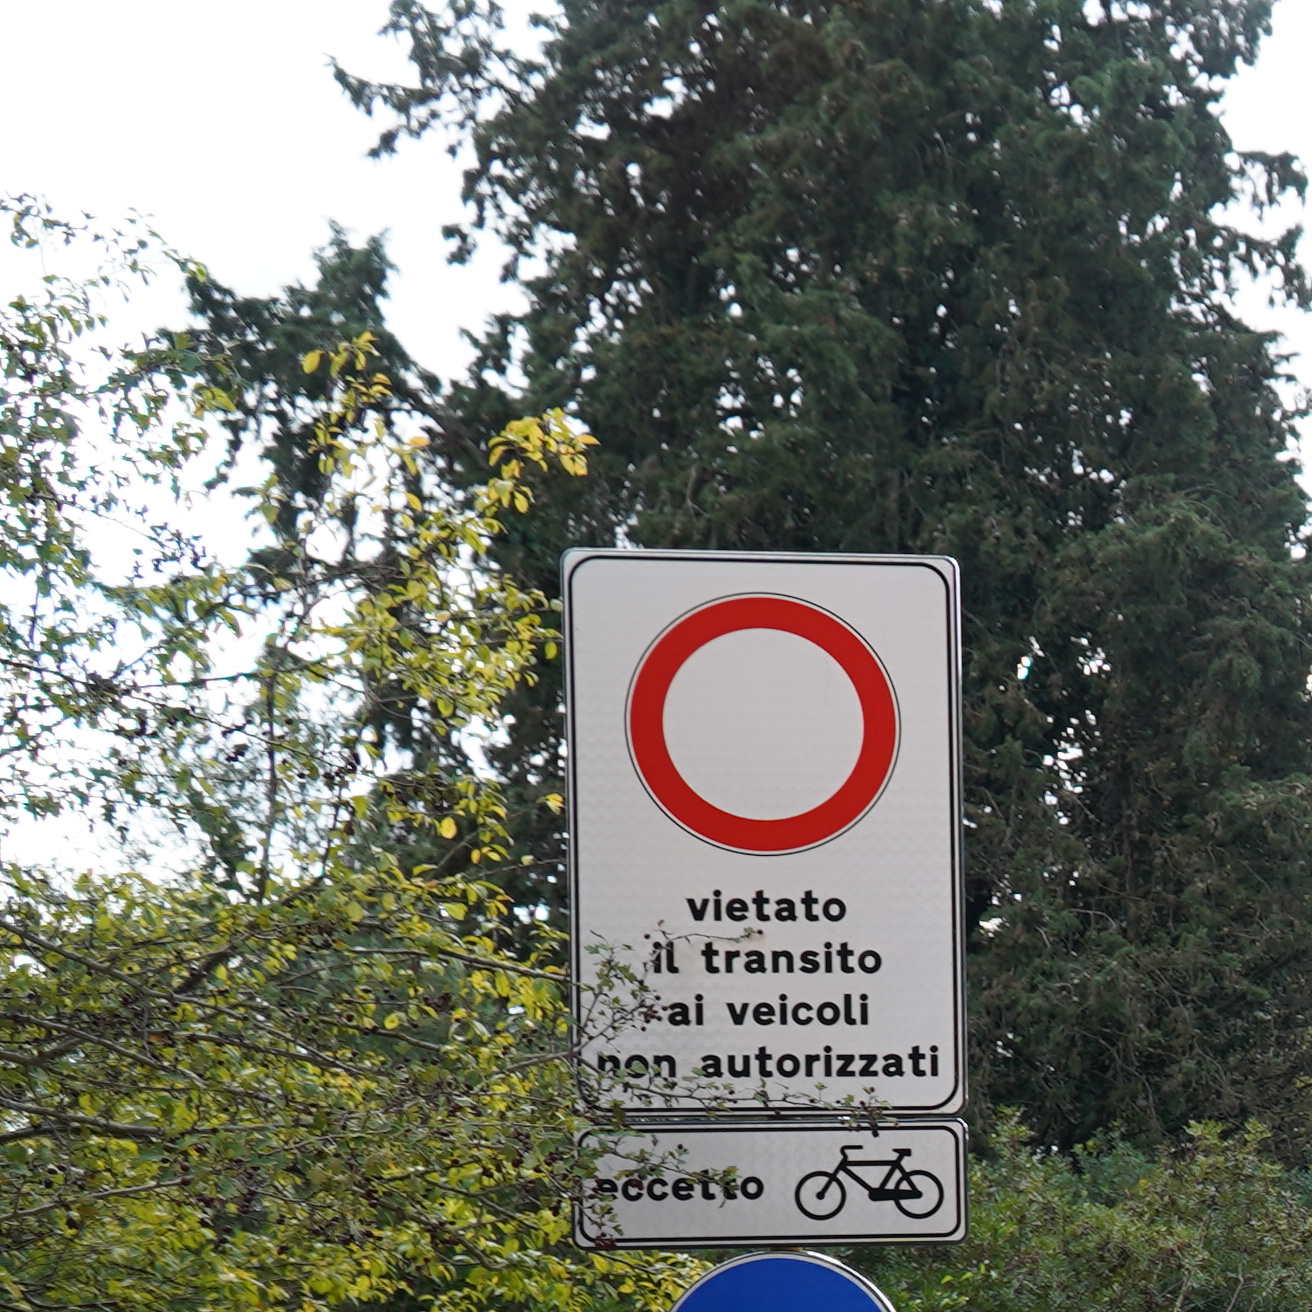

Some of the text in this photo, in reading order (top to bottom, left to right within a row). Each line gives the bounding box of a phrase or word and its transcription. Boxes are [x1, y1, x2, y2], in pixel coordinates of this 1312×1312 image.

[685, 889, 847, 923] vietato
[653, 941, 882, 974] il transito
[668, 993, 869, 1027] ai veicoli
[597, 1045, 939, 1079] non autorizzati
[597, 1169, 765, 1202] eccetto
